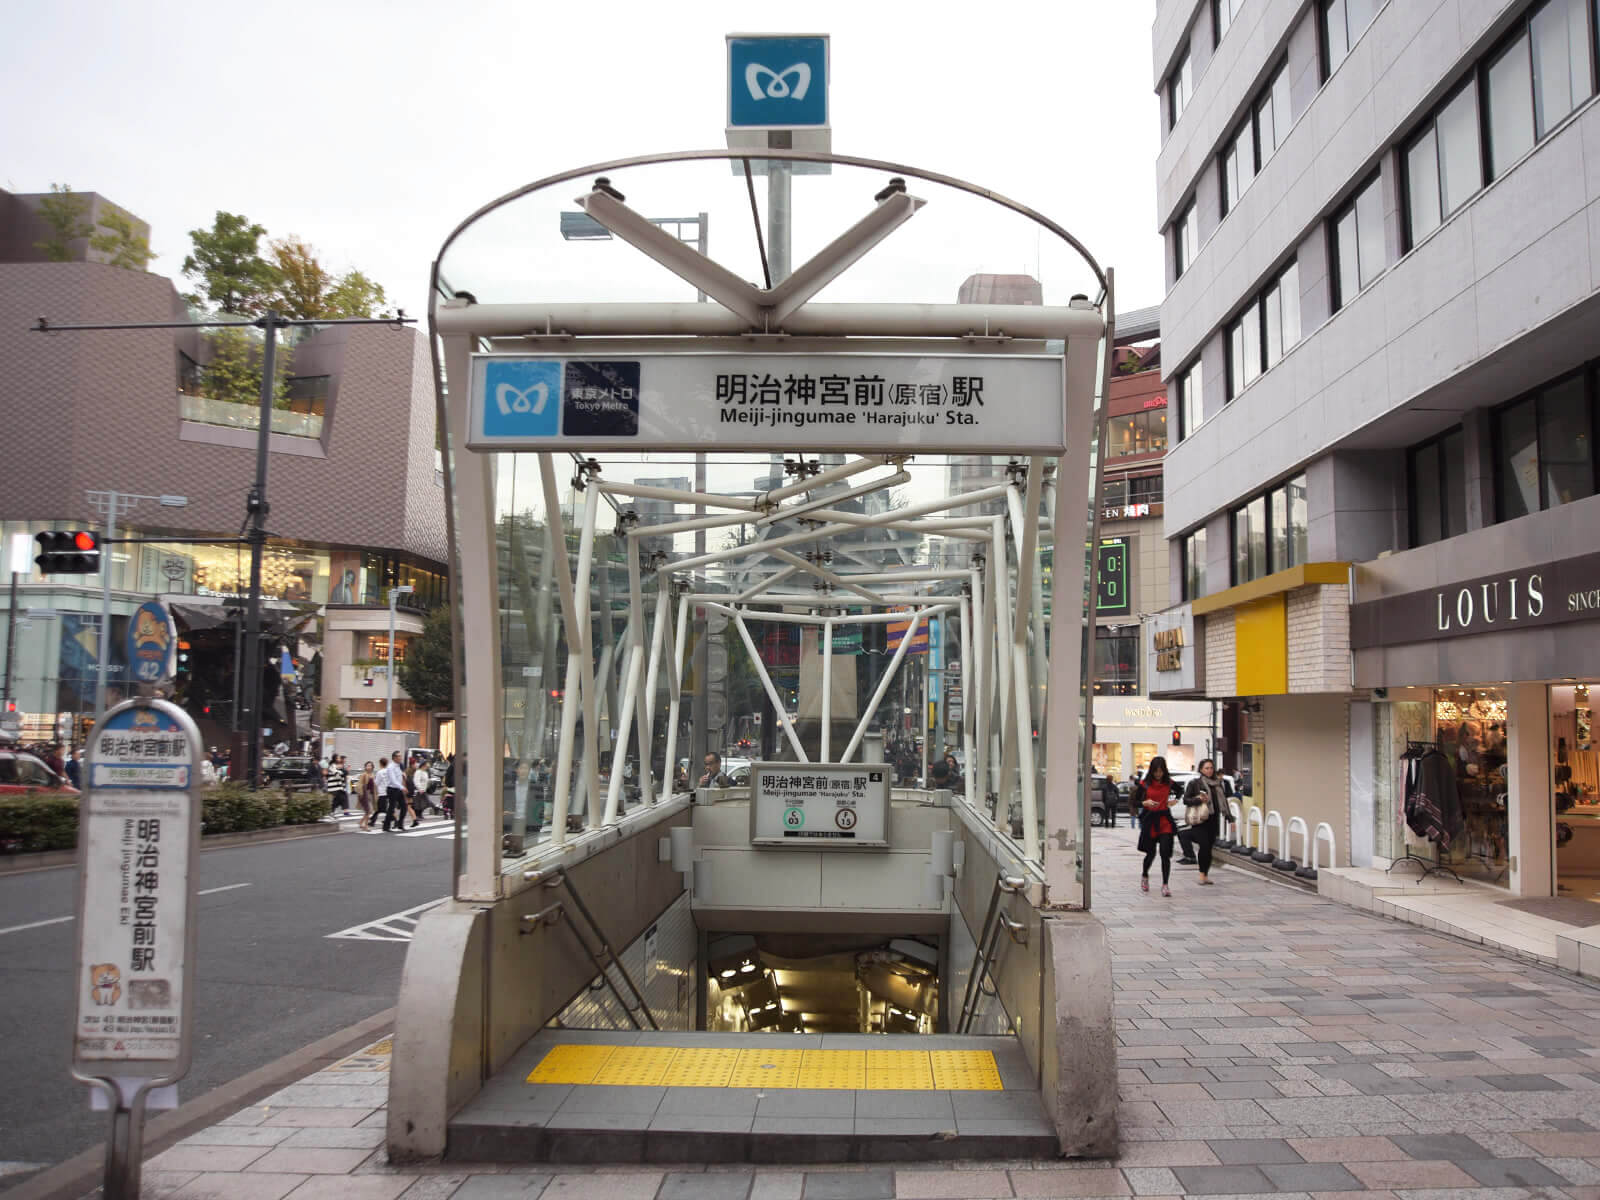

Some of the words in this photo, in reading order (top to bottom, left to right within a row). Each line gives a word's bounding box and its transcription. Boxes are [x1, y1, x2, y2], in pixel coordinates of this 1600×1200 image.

[571, 387, 633, 400] 東京メトロ
[575, 401, 600, 411] Tokyo
[602, 401, 629, 410] Metro
[719, 408, 857, 427] Meiji-jingumae
[862, 411, 940, 426] 'Harajuku'
[945, 410, 979, 425] Sta.
[1437, 574, 1544, 631] LOUIS
[138, 661, 160, 680] 42
[101, 737, 186, 757] 明治神宮前駅
[763, 790, 817, 798] Meiji-jingumae
[131, 819, 160, 972] 明治神宮前駅
